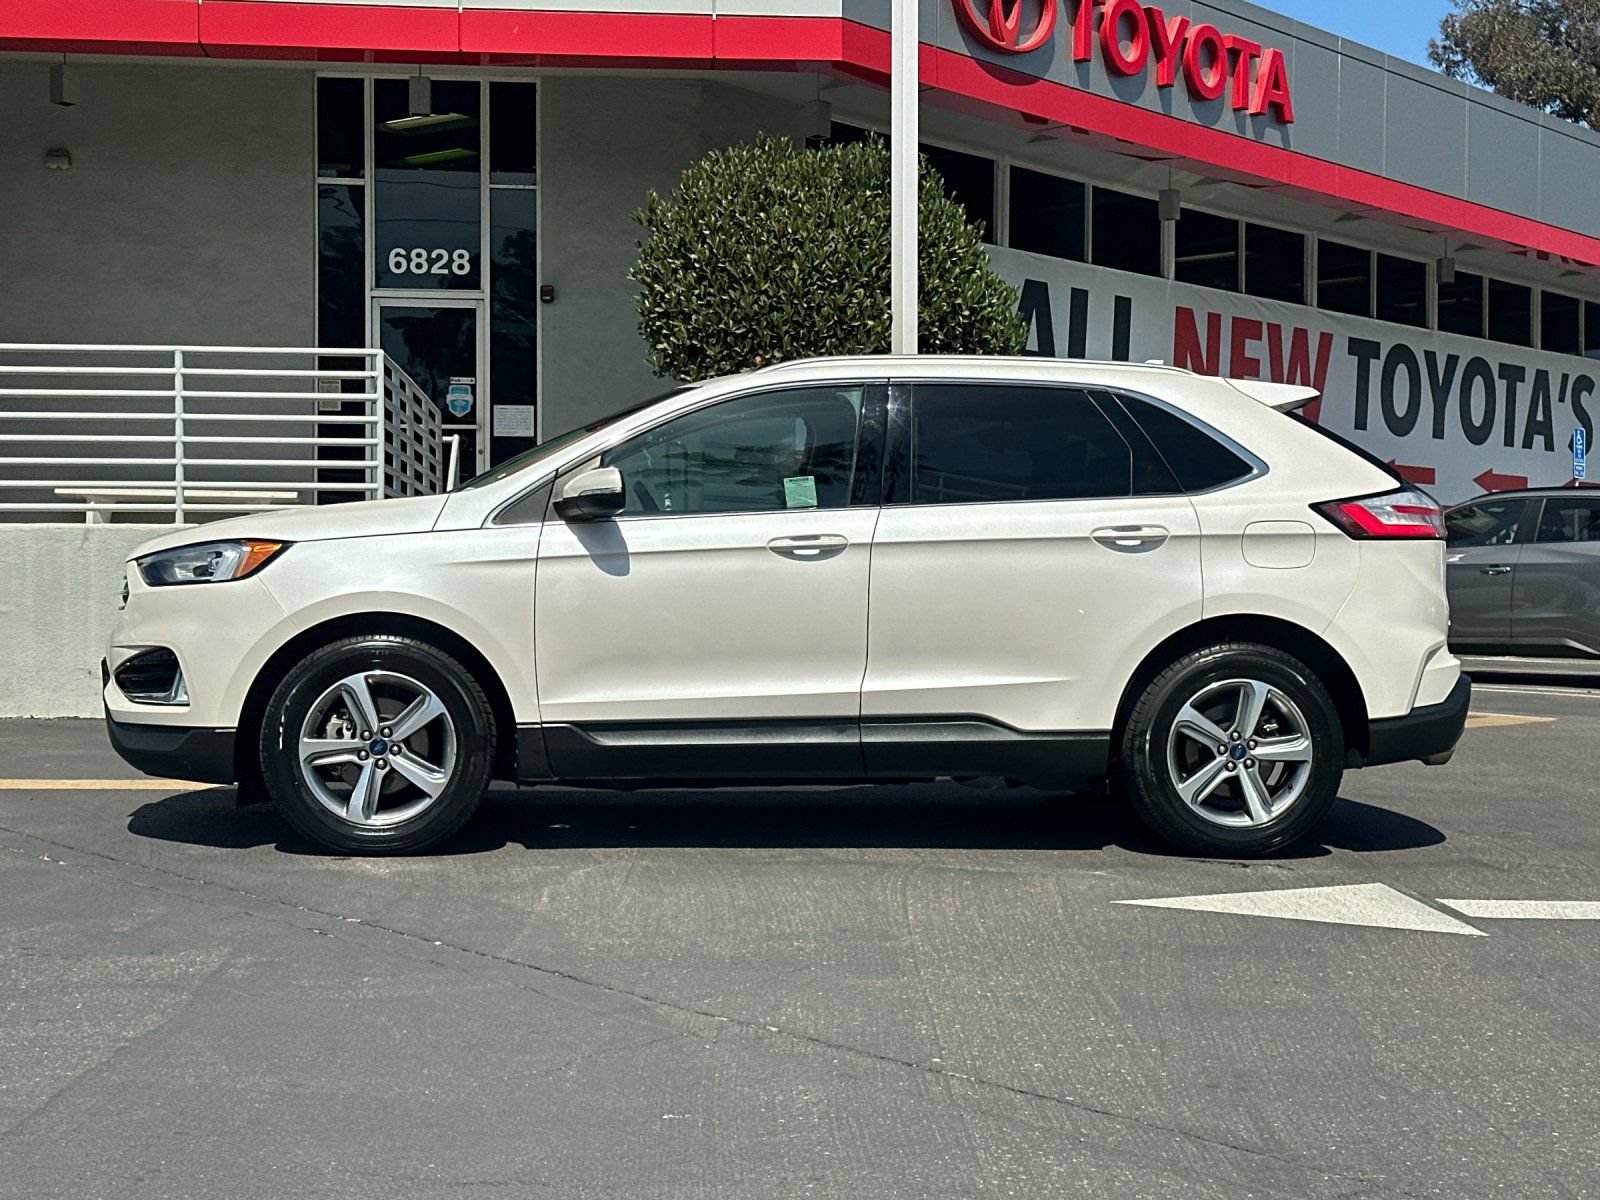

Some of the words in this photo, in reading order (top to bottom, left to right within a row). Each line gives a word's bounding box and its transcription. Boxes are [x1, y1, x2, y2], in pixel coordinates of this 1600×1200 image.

[1071, 0, 1295, 124] TOYOTA
[388, 247, 471, 275] 6828
[1173, 305, 1334, 425] NEW
[1347, 336, 1596, 456] TOYOTA'S
